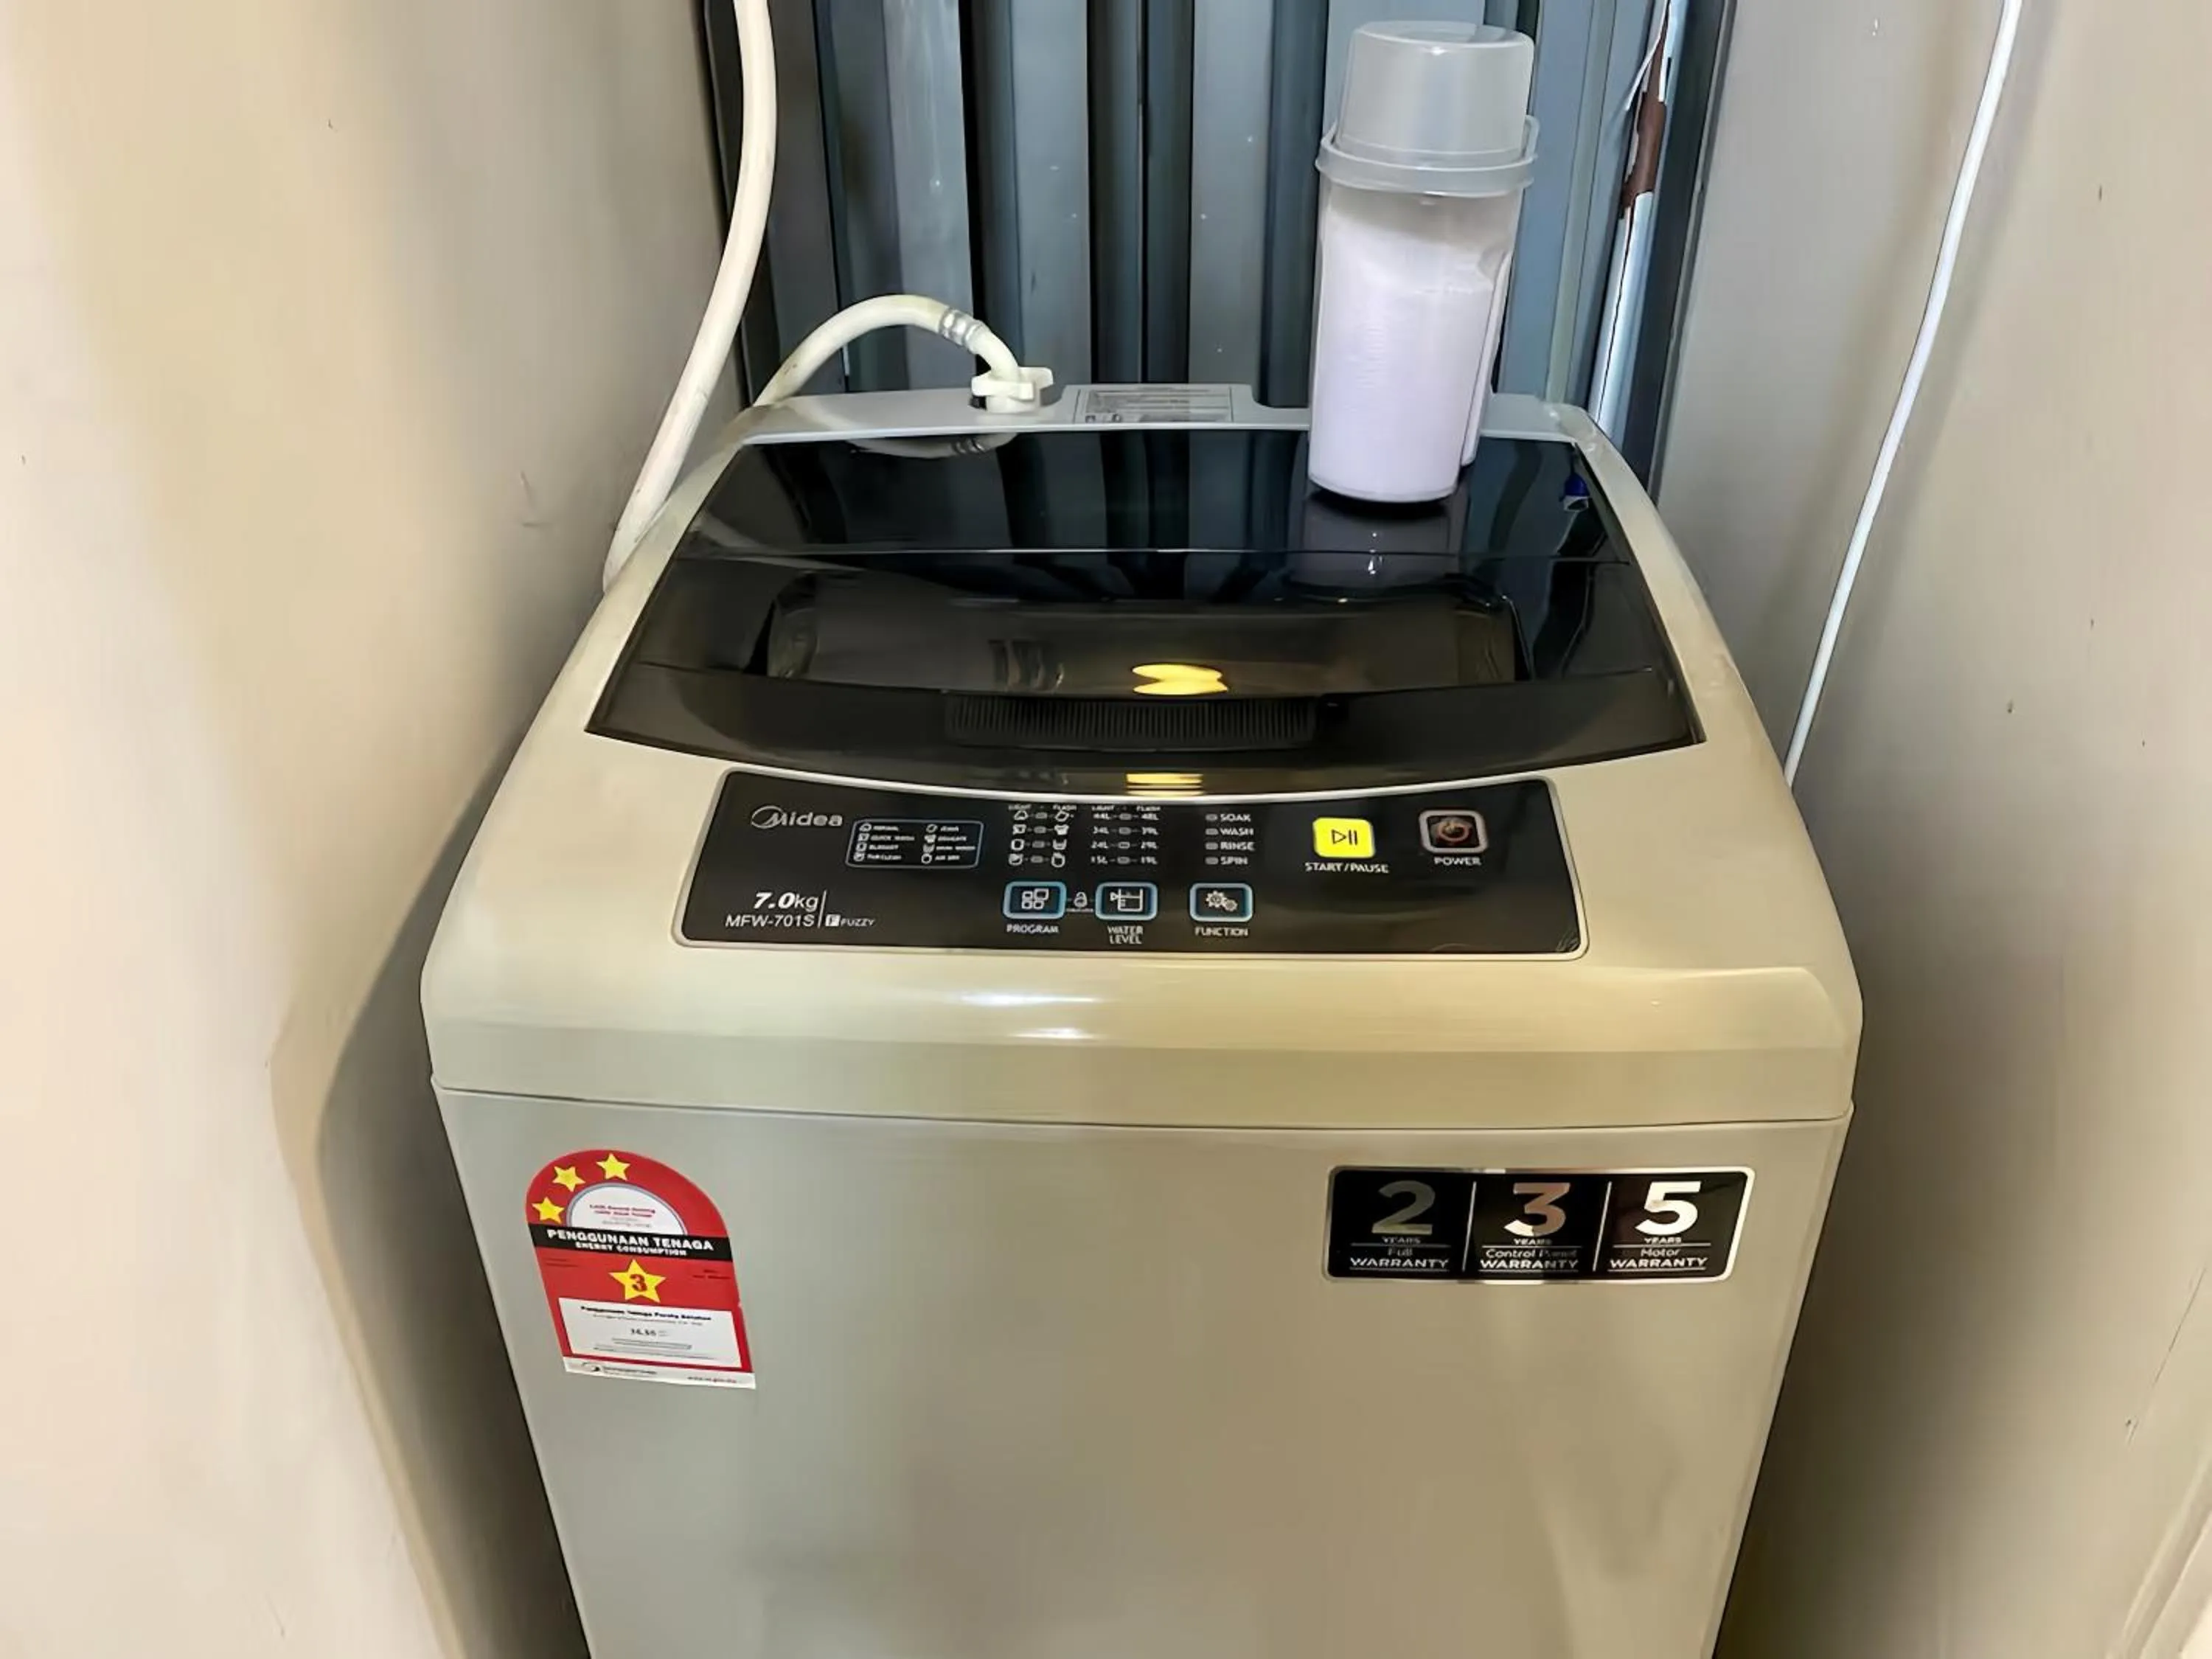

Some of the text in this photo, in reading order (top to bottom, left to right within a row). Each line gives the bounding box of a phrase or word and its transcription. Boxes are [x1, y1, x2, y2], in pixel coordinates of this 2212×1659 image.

[751, 805, 843, 829] Midea
[1220, 813, 1251, 822] SOAK
[1220, 827, 1254, 836] WASH
[1220, 841, 1255, 851] RINSE
[1220, 856, 1248, 865] SPIN
[1434, 856, 1481, 866] POWER
[753, 891, 819, 911] 7.0kg
[726, 913, 815, 928] MFW-701S
[1006, 923, 1059, 934] PROGRAM
[1107, 925, 1143, 936] WATER
[1194, 927, 1249, 937] FUNCTION
[1109, 935, 1142, 945] LEVEL
[1371, 1180, 1436, 1235] 2
[1503, 1182, 1571, 1237] 3
[1635, 1181, 1701, 1235] 5
[547, 1229, 714, 1251] PENGGUNAAN TENAGA
[1486, 1248, 1537, 1259] Control
[1640, 1248, 1680, 1257] Motor
[1350, 1257, 1450, 1269] WARRANTY
[1480, 1259, 1579, 1269] WARRANTY
[1609, 1257, 1708, 1269] WARRANTY
[630, 1273, 647, 1292] 3
